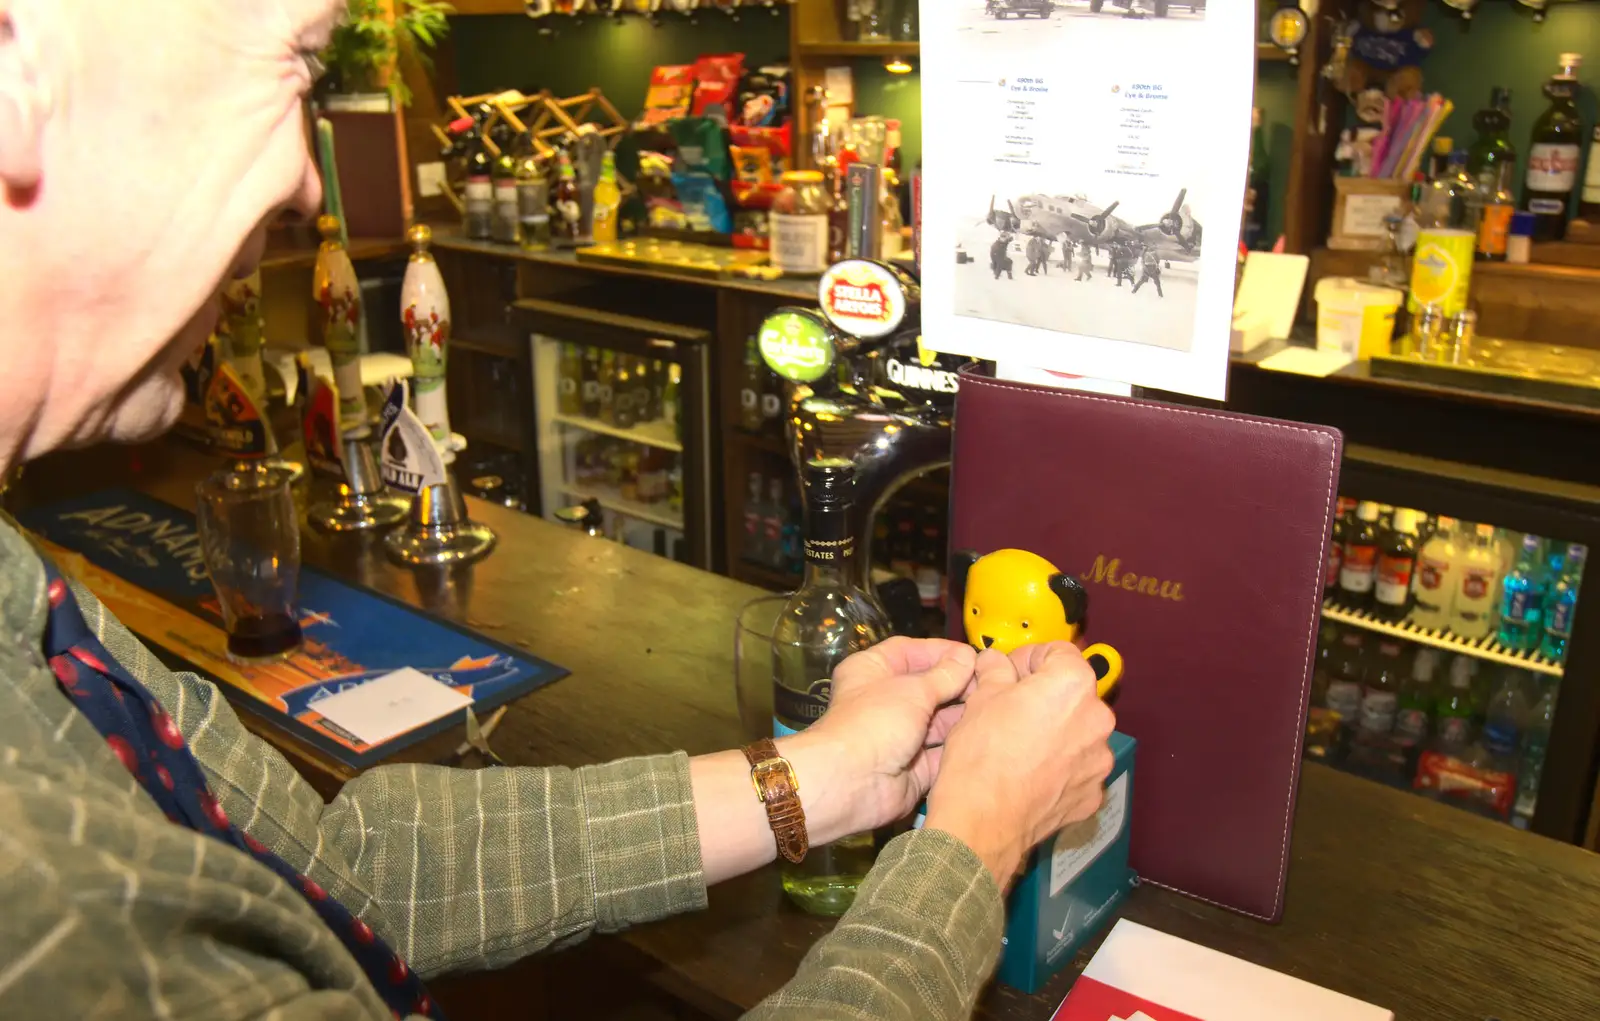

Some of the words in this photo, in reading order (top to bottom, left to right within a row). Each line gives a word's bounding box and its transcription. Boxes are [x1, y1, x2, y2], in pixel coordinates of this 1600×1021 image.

[835, 285, 881, 303] STELLA
[887, 358, 960, 393] GUINNES
[1080, 553, 1186, 602] Menu
